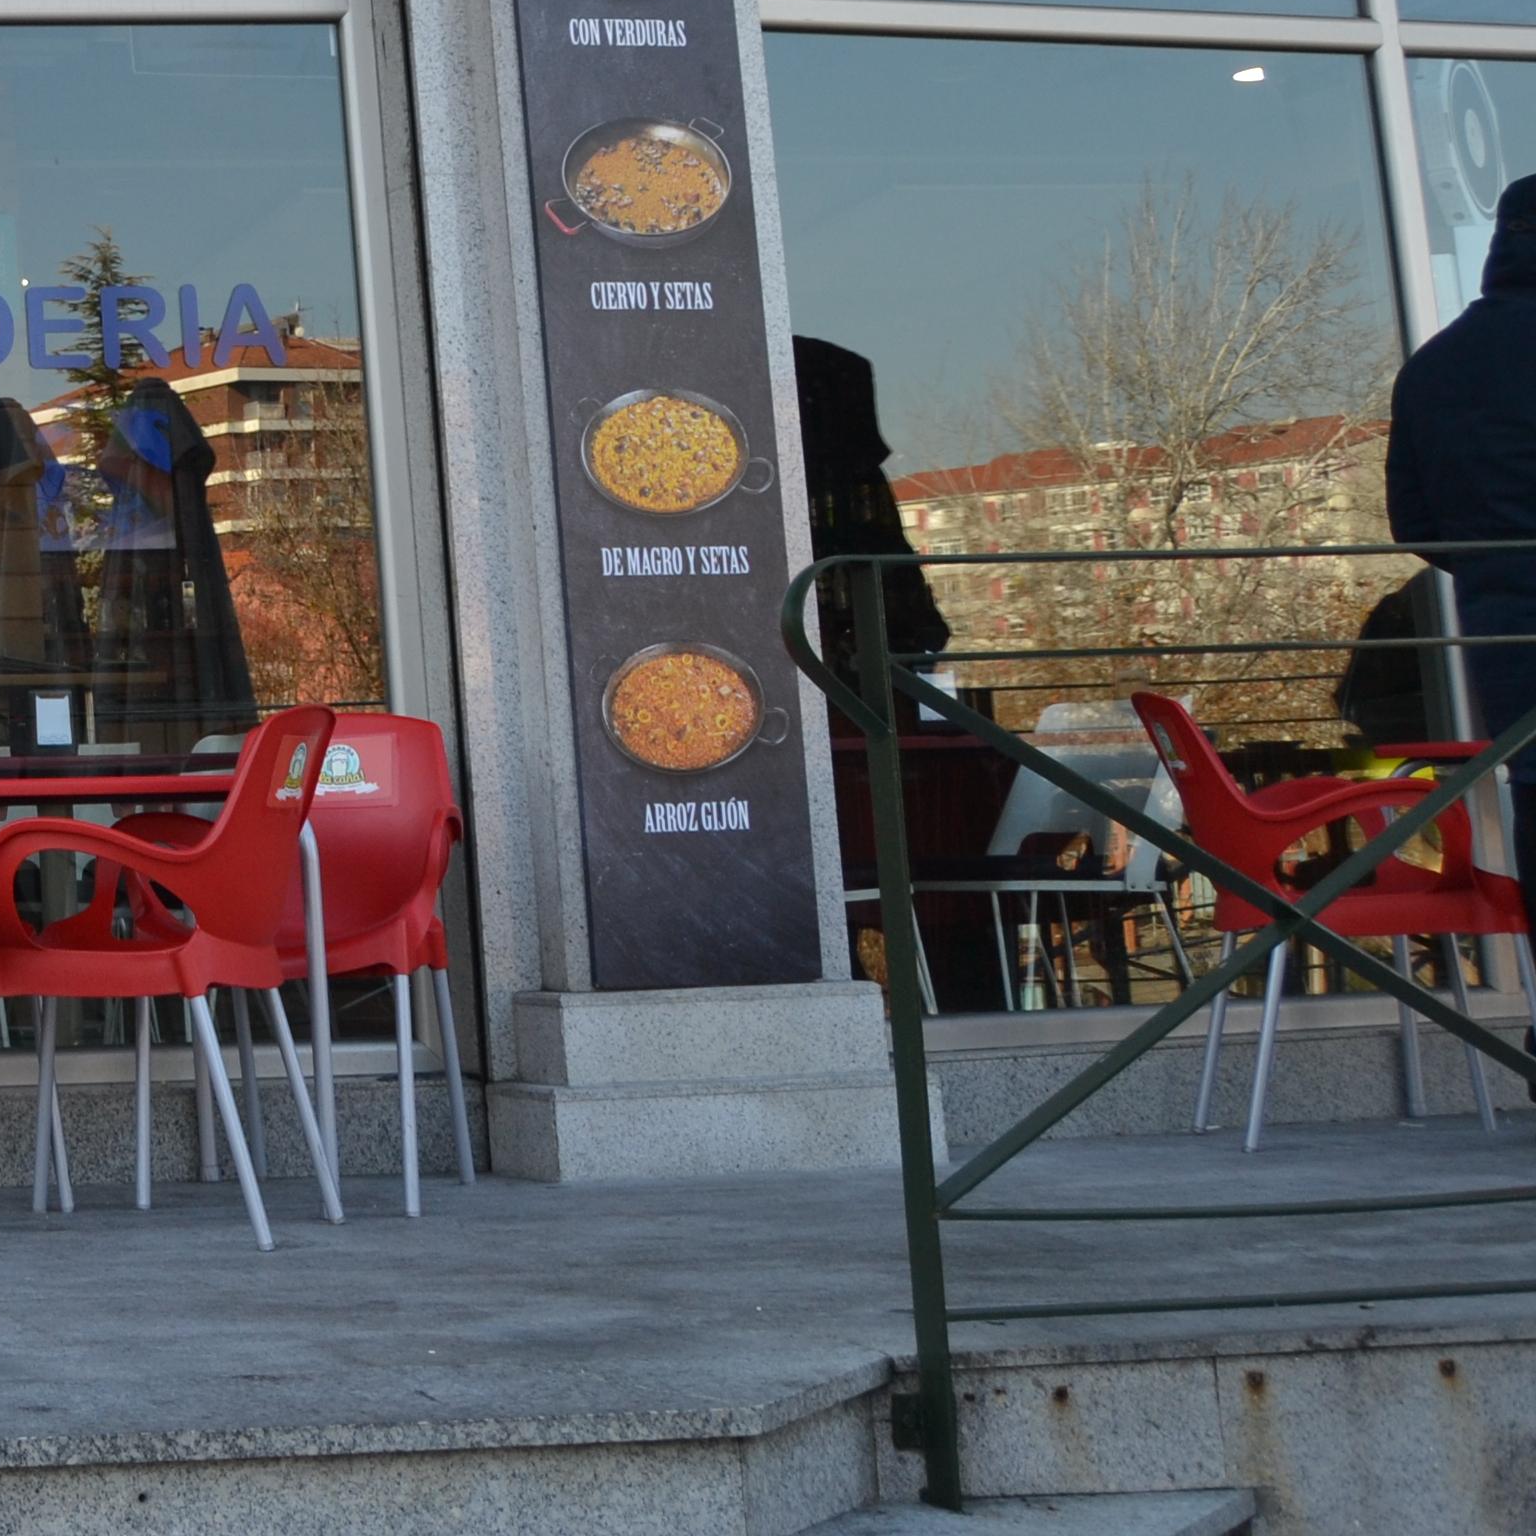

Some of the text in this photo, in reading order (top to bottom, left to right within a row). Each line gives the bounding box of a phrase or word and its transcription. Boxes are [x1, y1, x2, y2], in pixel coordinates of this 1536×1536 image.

[569, 18, 686, 47] CON VERDURAS
[590, 282, 713, 311] CIERVO Y SETAS
[601, 546, 749, 576] DE MAGRO Y SETAS
[644, 797, 750, 833] ARROZ GIJÓN
